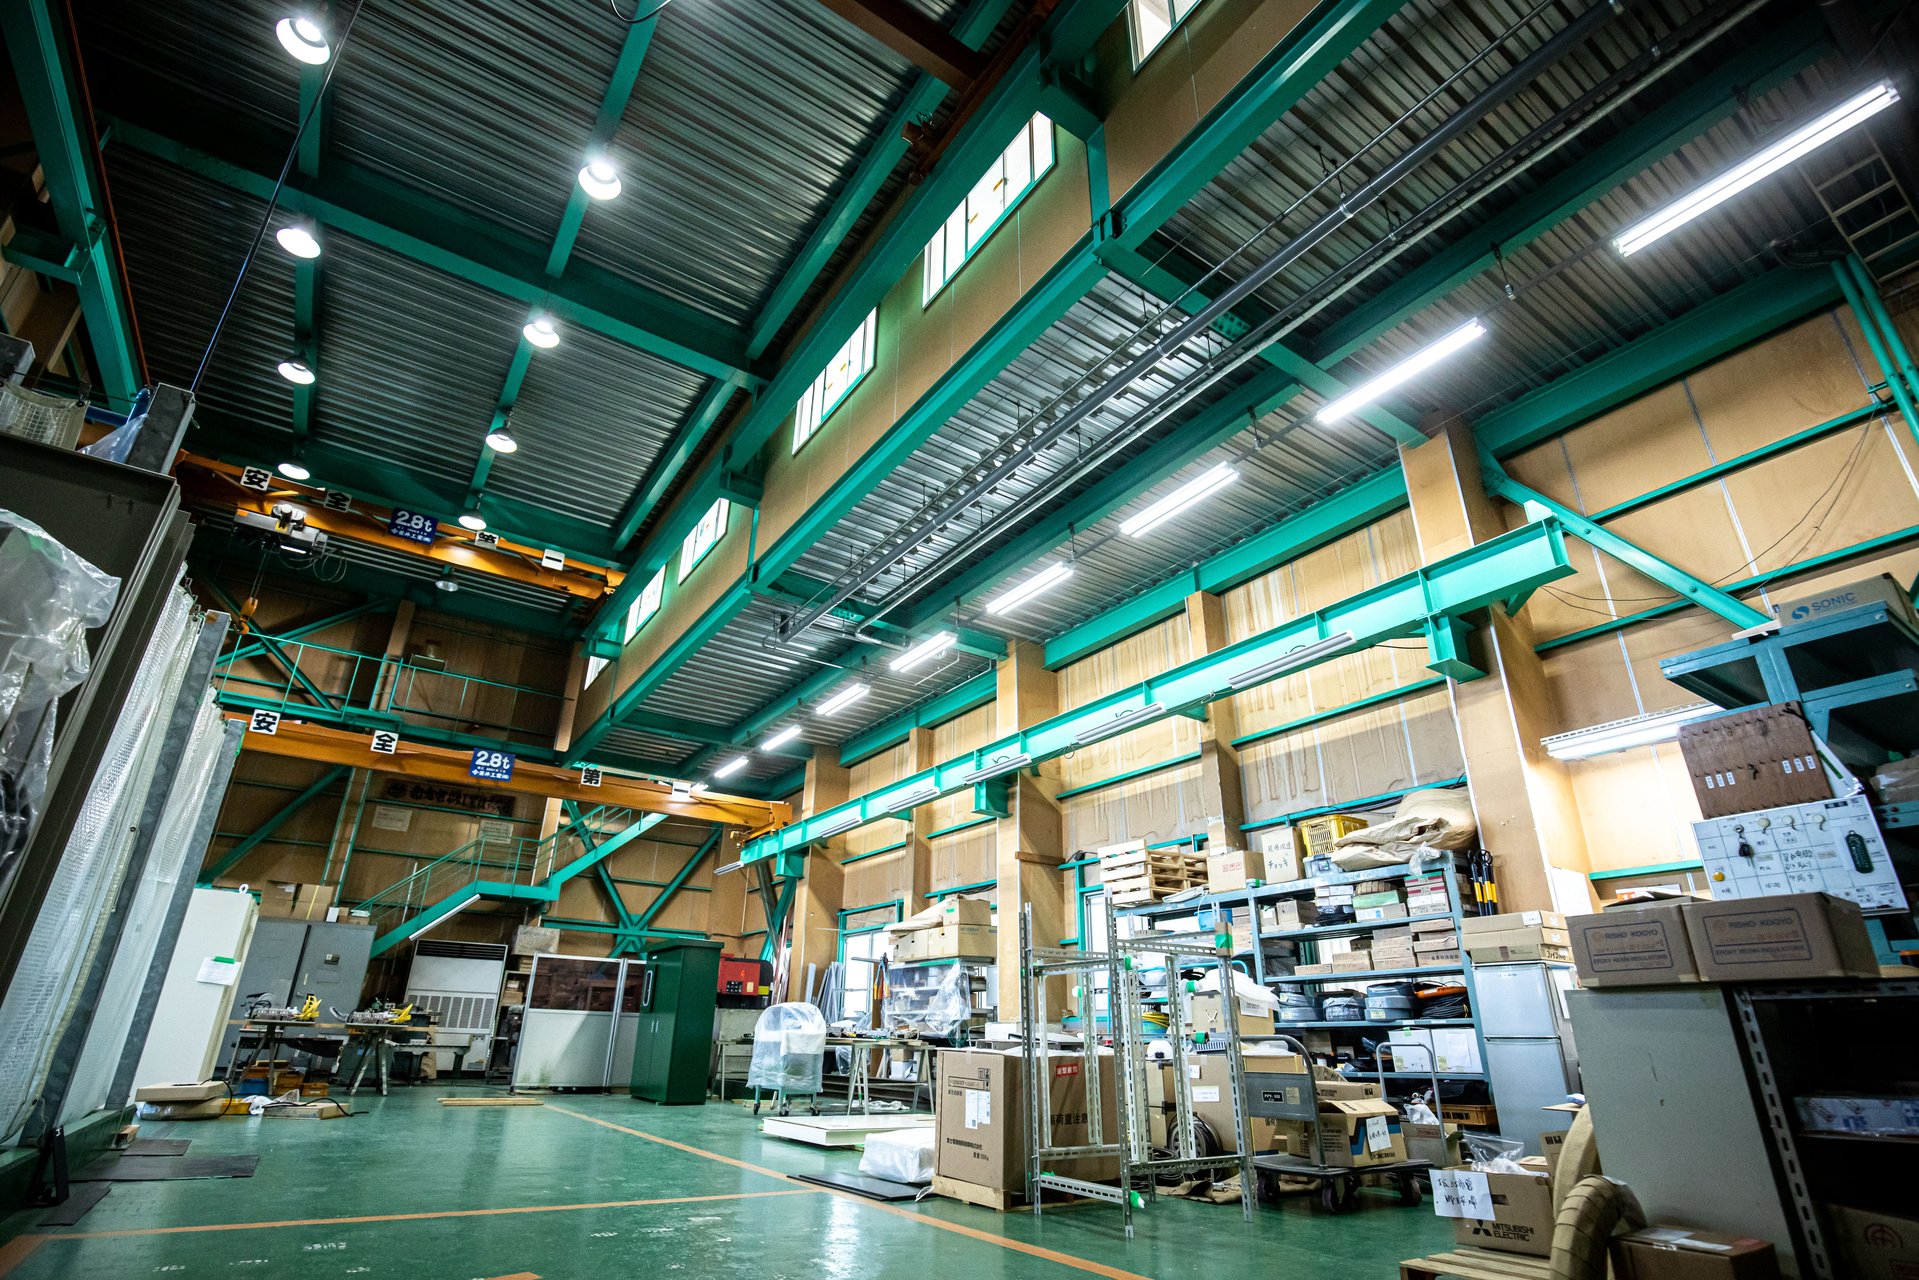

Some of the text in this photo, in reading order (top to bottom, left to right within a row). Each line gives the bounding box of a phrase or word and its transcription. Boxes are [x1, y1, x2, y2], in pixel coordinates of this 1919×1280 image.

[245, 469, 269, 489] 安
[326, 491, 348, 512] 全
[395, 510, 433, 533] 2.8t
[1811, 592, 1856, 611] SONIC
[252, 712, 278, 733] 安
[373, 733, 396, 753] 全
[582, 767, 601, 785] 第
[475, 750, 511, 770] 2.8t
[1604, 929, 1658, 940] RISHO KOGYO
[1492, 1222, 1535, 1235] MITSUBISHI
[1493, 1230, 1530, 1242] ELECTRIC
